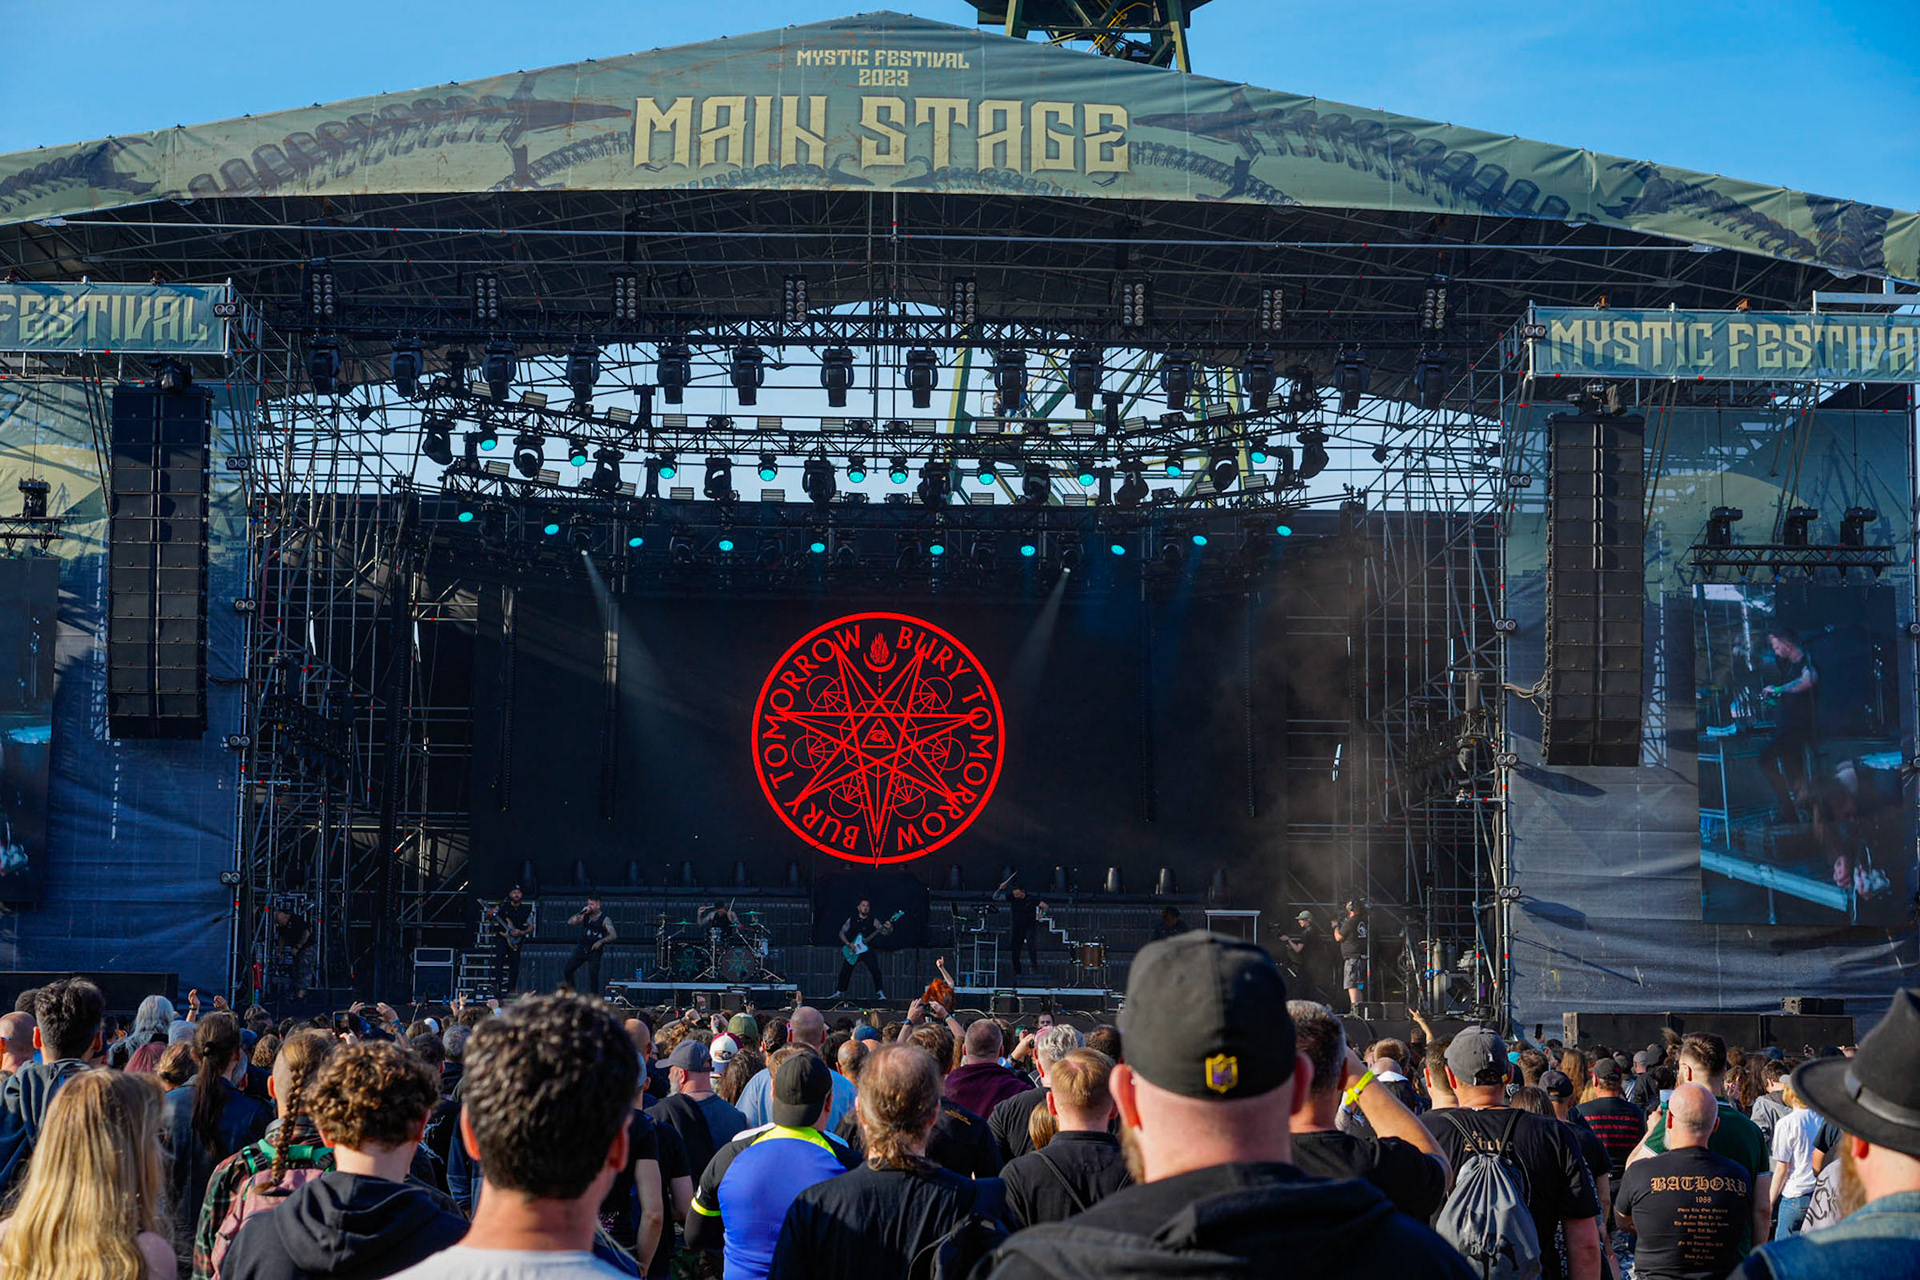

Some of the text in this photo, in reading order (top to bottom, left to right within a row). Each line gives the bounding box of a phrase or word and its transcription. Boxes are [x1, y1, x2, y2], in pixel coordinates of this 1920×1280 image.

[797, 49, 970, 69] MYSTIC FESTIVAL
[859, 69, 909, 87] 2023
[633, 95, 1131, 176] MAIN STAGE
[0, 294, 208, 343] FESTIVAL
[1550, 319, 1920, 373] MYSTIC FESTIVA
[762, 625, 861, 850] BURY TOMORROW
[896, 625, 995, 851] BURY TOMORROW
